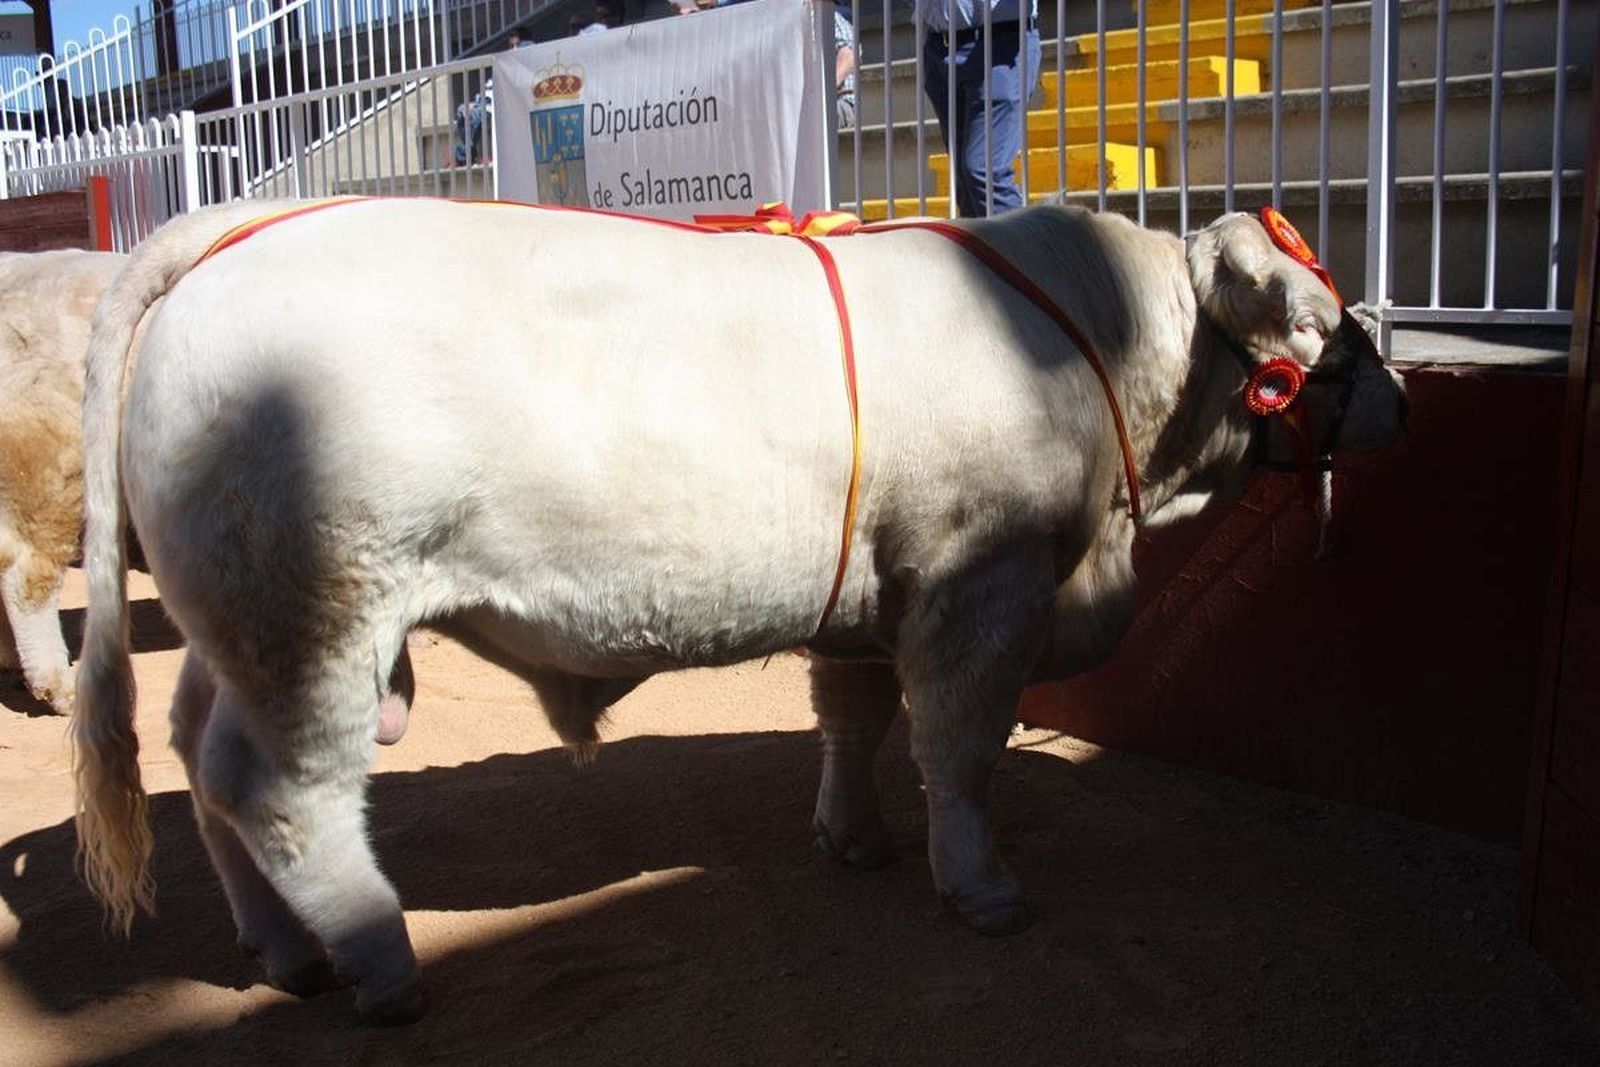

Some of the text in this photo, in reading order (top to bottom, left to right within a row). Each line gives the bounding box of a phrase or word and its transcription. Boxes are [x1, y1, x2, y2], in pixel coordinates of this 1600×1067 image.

[590, 87, 718, 143] Diputación
[593, 169, 753, 209] de Salamanca
